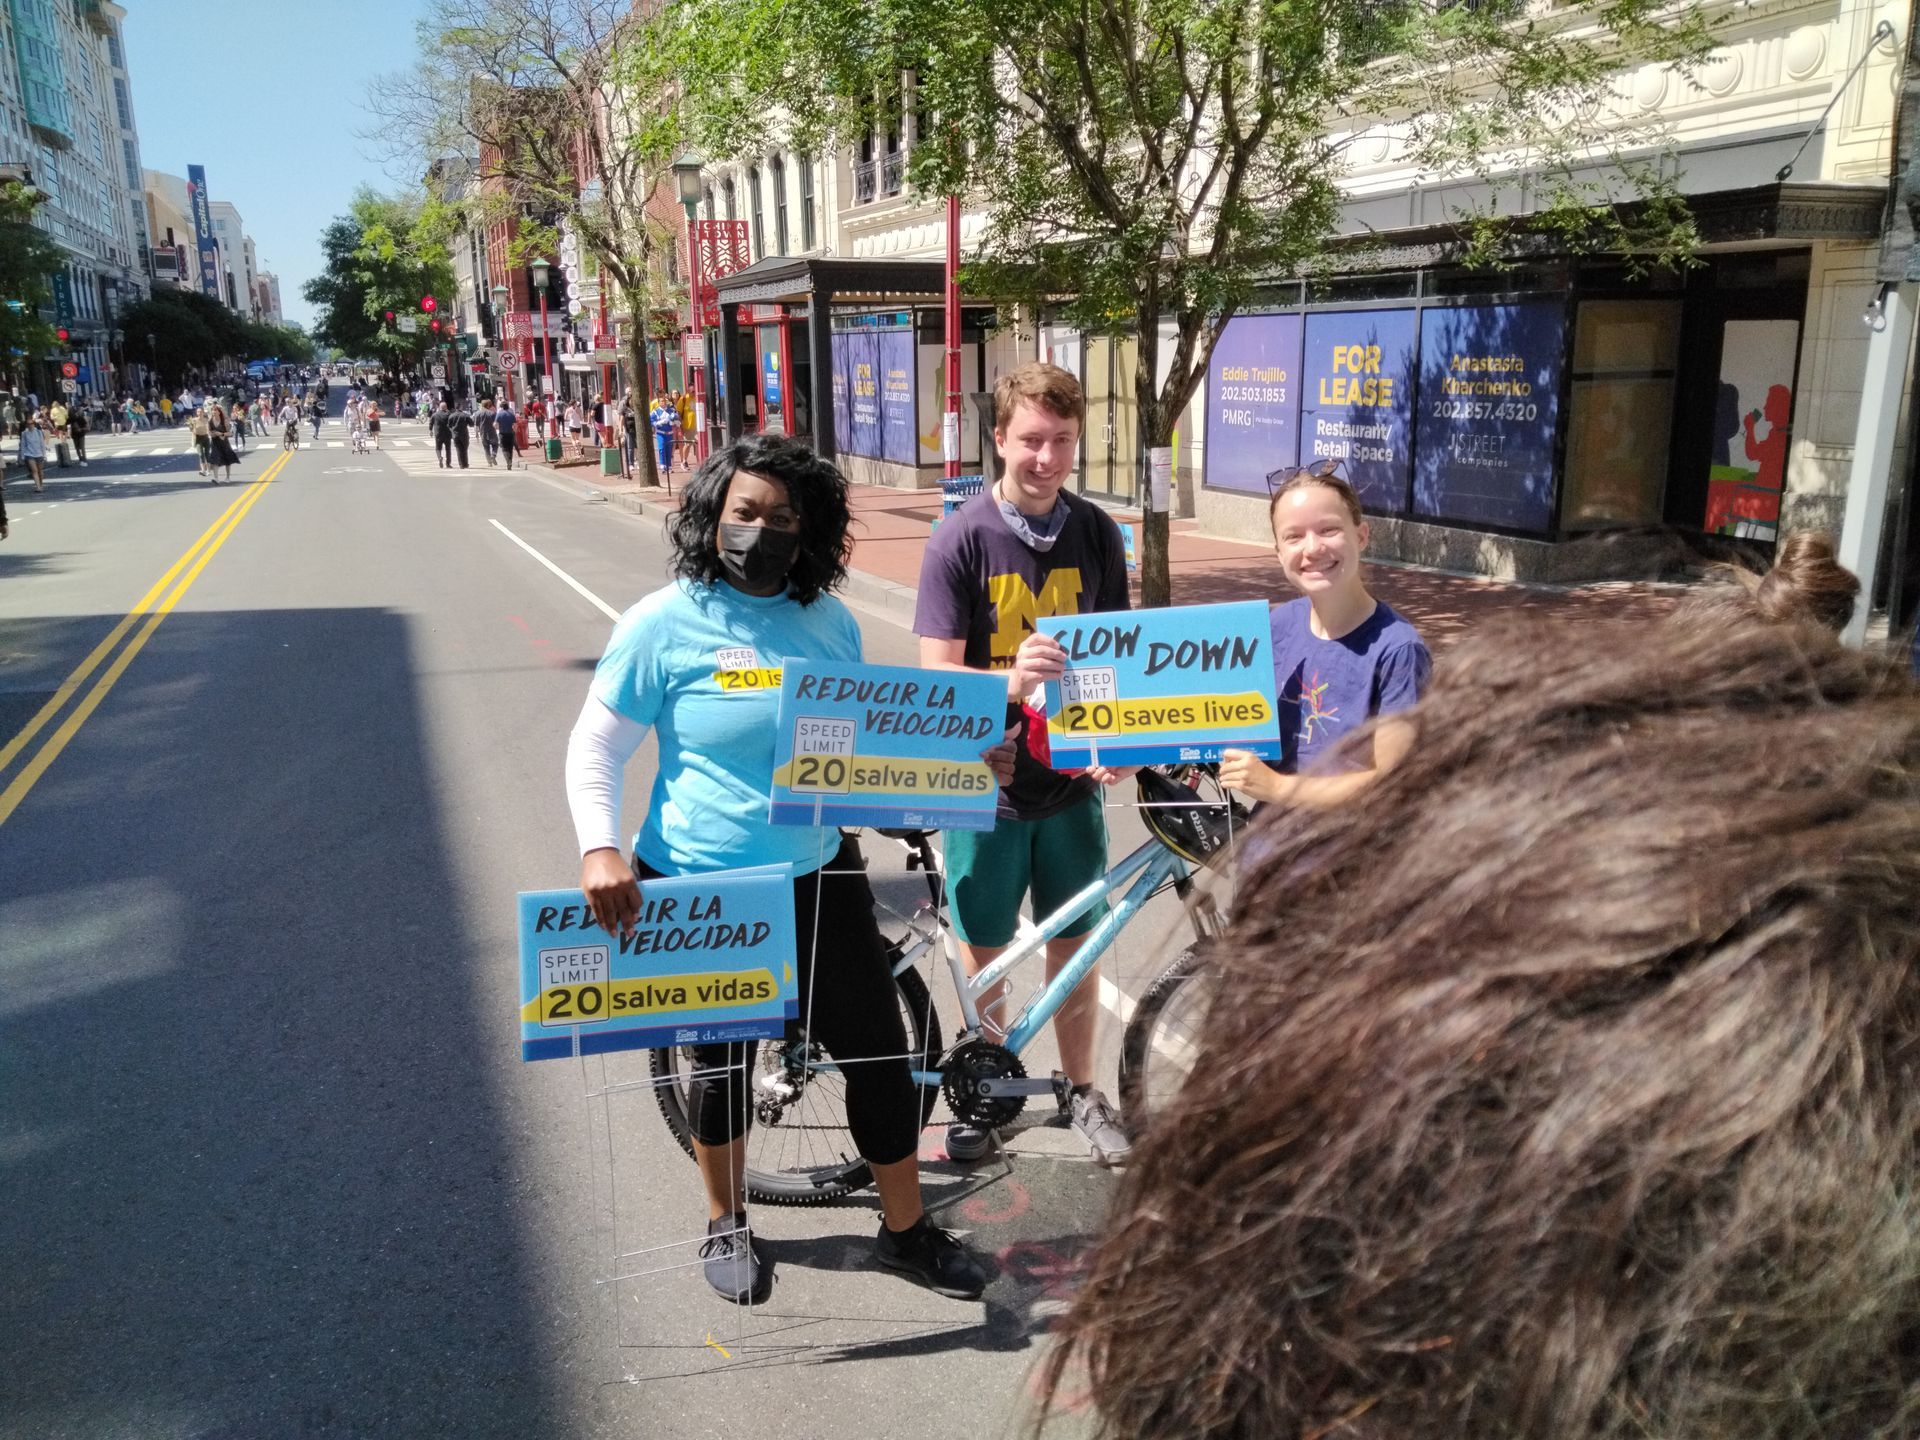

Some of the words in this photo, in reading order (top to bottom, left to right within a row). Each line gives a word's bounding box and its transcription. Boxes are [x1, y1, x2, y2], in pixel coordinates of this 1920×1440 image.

[703, 222, 744, 230] CHINA
[704, 230, 745, 239] TOWN
[1333, 345, 1381, 374] FOR
[1450, 354, 1524, 372] Anastasia
[1222, 367, 1249, 381] Eddie
[1252, 367, 1287, 384] Trujillo
[1221, 386, 1286, 402] 202.503.1853
[1320, 378, 1393, 406] LEASE
[1441, 377, 1531, 396] Kharchenko
[1222, 409, 1251, 426] PMRG
[1433, 401, 1537, 421] 202.857.4320
[1314, 439, 1350, 459] Retail
[1352, 443, 1394, 463] Space
[719, 650, 754, 660] SPEED
[1053, 624, 1141, 661] SLOW
[1143, 636, 1259, 676] DOWN
[725, 660, 752, 668] LIMIT
[726, 670, 758, 688] 20
[1063, 675, 1111, 687] SPEED
[796, 675, 919, 706] REDUCIR
[926, 684, 955, 710] LA
[1069, 688, 1108, 701] LIMIT
[864, 708, 994, 740] VELOCIDAD
[1069, 704, 1113, 731] 20
[1124, 706, 1195, 726] saves
[1204, 701, 1264, 722] lives
[800, 723, 851, 738] SPEED
[803, 739, 846, 753] LIMIT
[797, 757, 846, 787] 20
[854, 765, 917, 789] salva
[926, 767, 988, 791] vidas
[535, 898, 678, 933] REDIR
[688, 895, 722, 921] LA
[619, 921, 771, 955] VELOCIDAD
[545, 952, 603, 969] SPEED
[550, 968, 599, 984] LIMIT
[548, 986, 603, 1019] 20
[613, 985, 686, 1010] salva
[696, 978, 770, 1002] vidas
